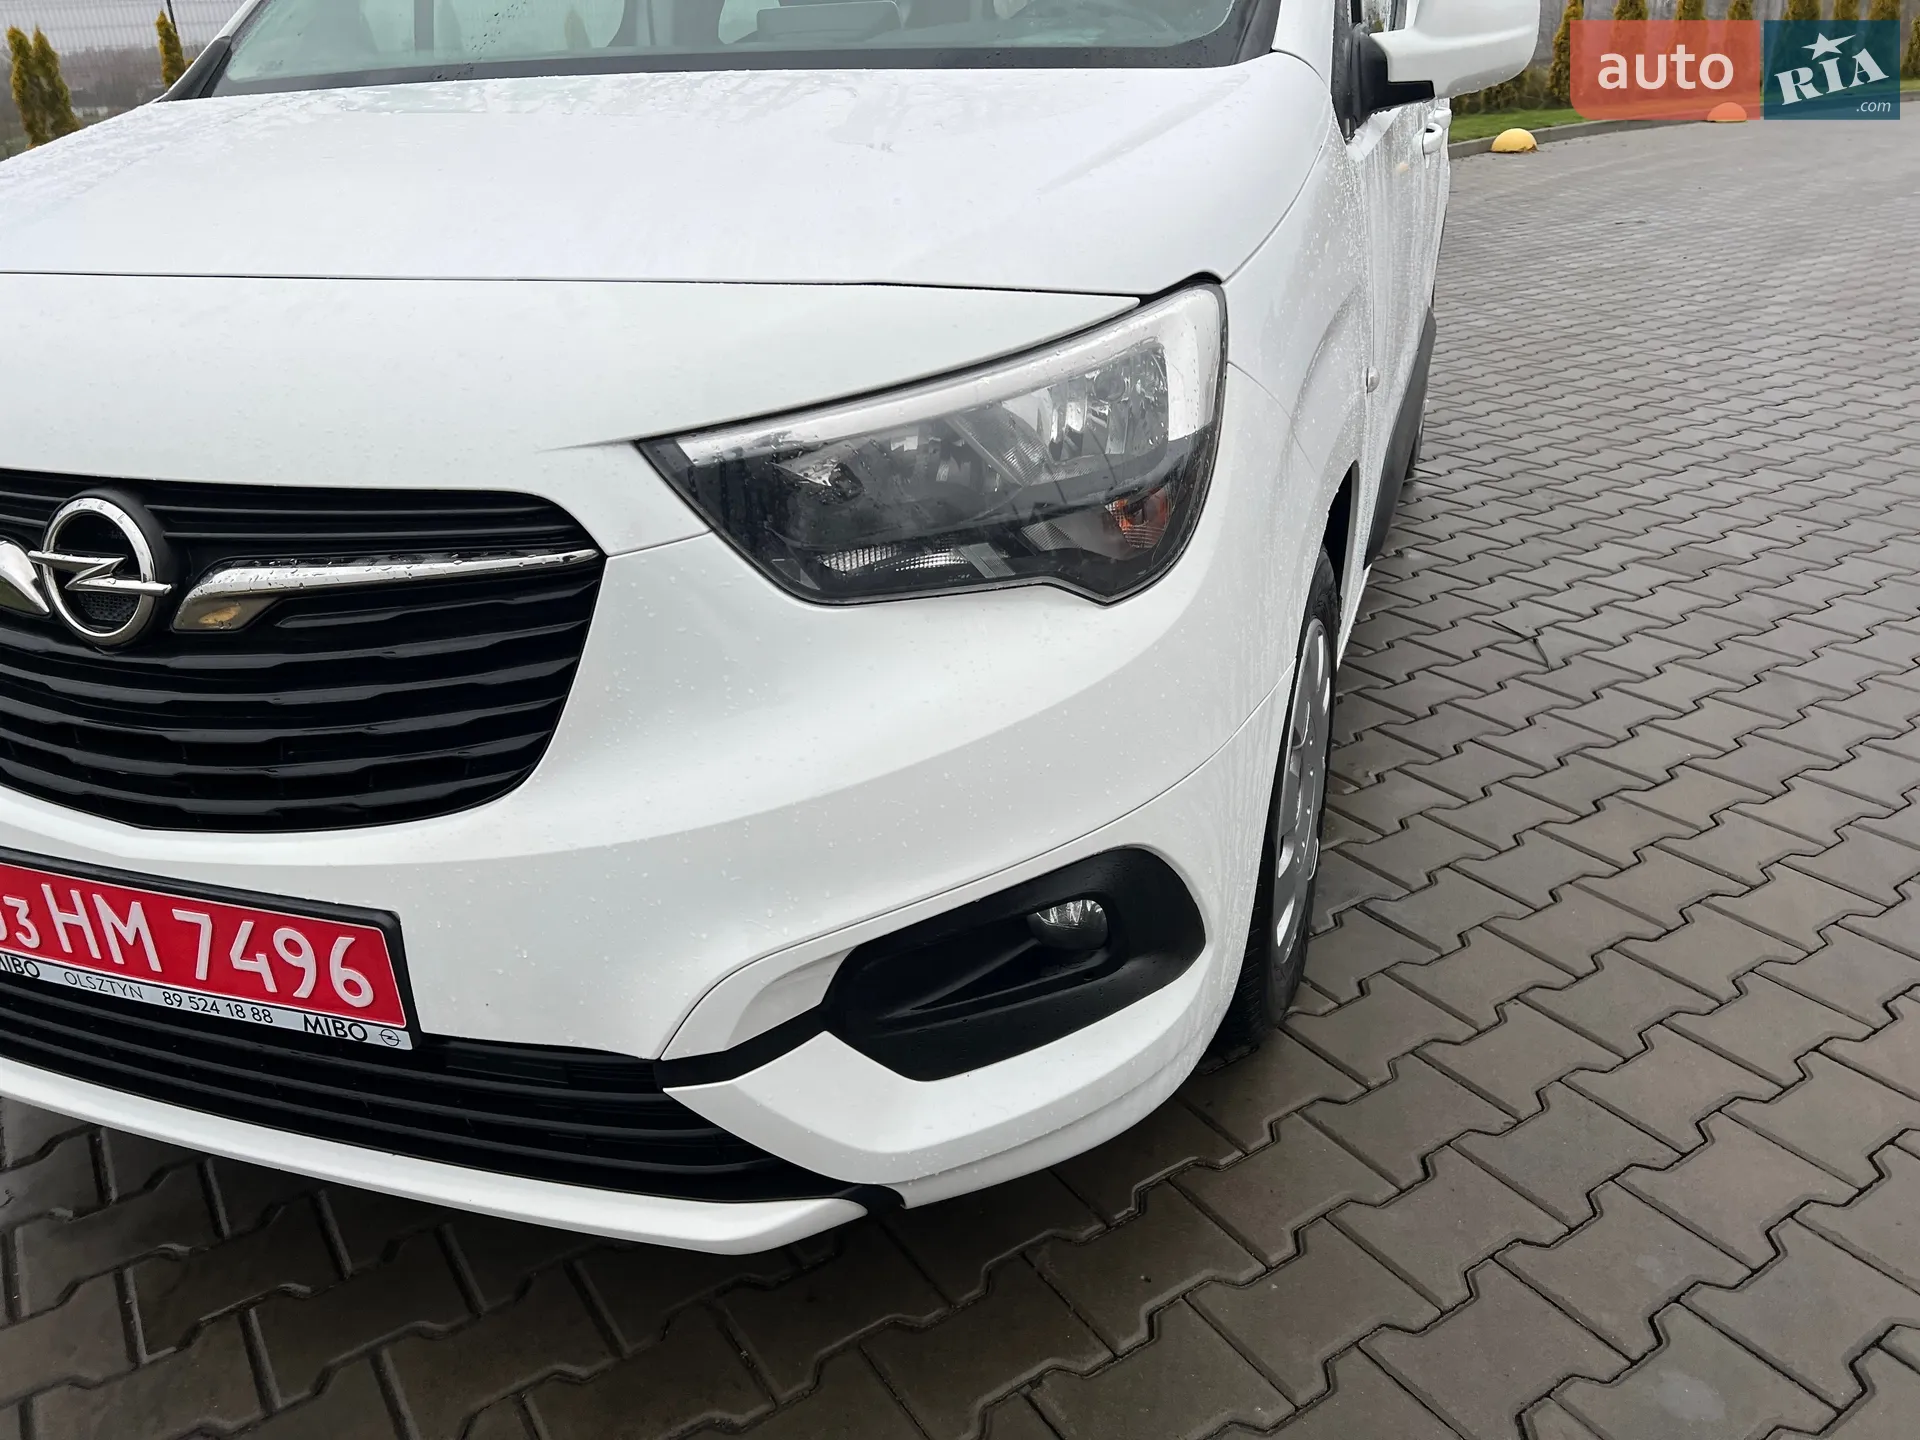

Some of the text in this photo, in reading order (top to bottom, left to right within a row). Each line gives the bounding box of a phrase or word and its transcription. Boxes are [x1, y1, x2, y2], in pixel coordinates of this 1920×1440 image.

[0, 884, 374, 1008] 3 HM 7496
[64, 971, 144, 1000] OLSZTYN
[162, 991, 183, 1007] 89
[188, 996, 220, 1015] 524
[225, 1003, 246, 1019] 18
[250, 1007, 274, 1024] 88
[303, 1014, 368, 1042] MIBO
